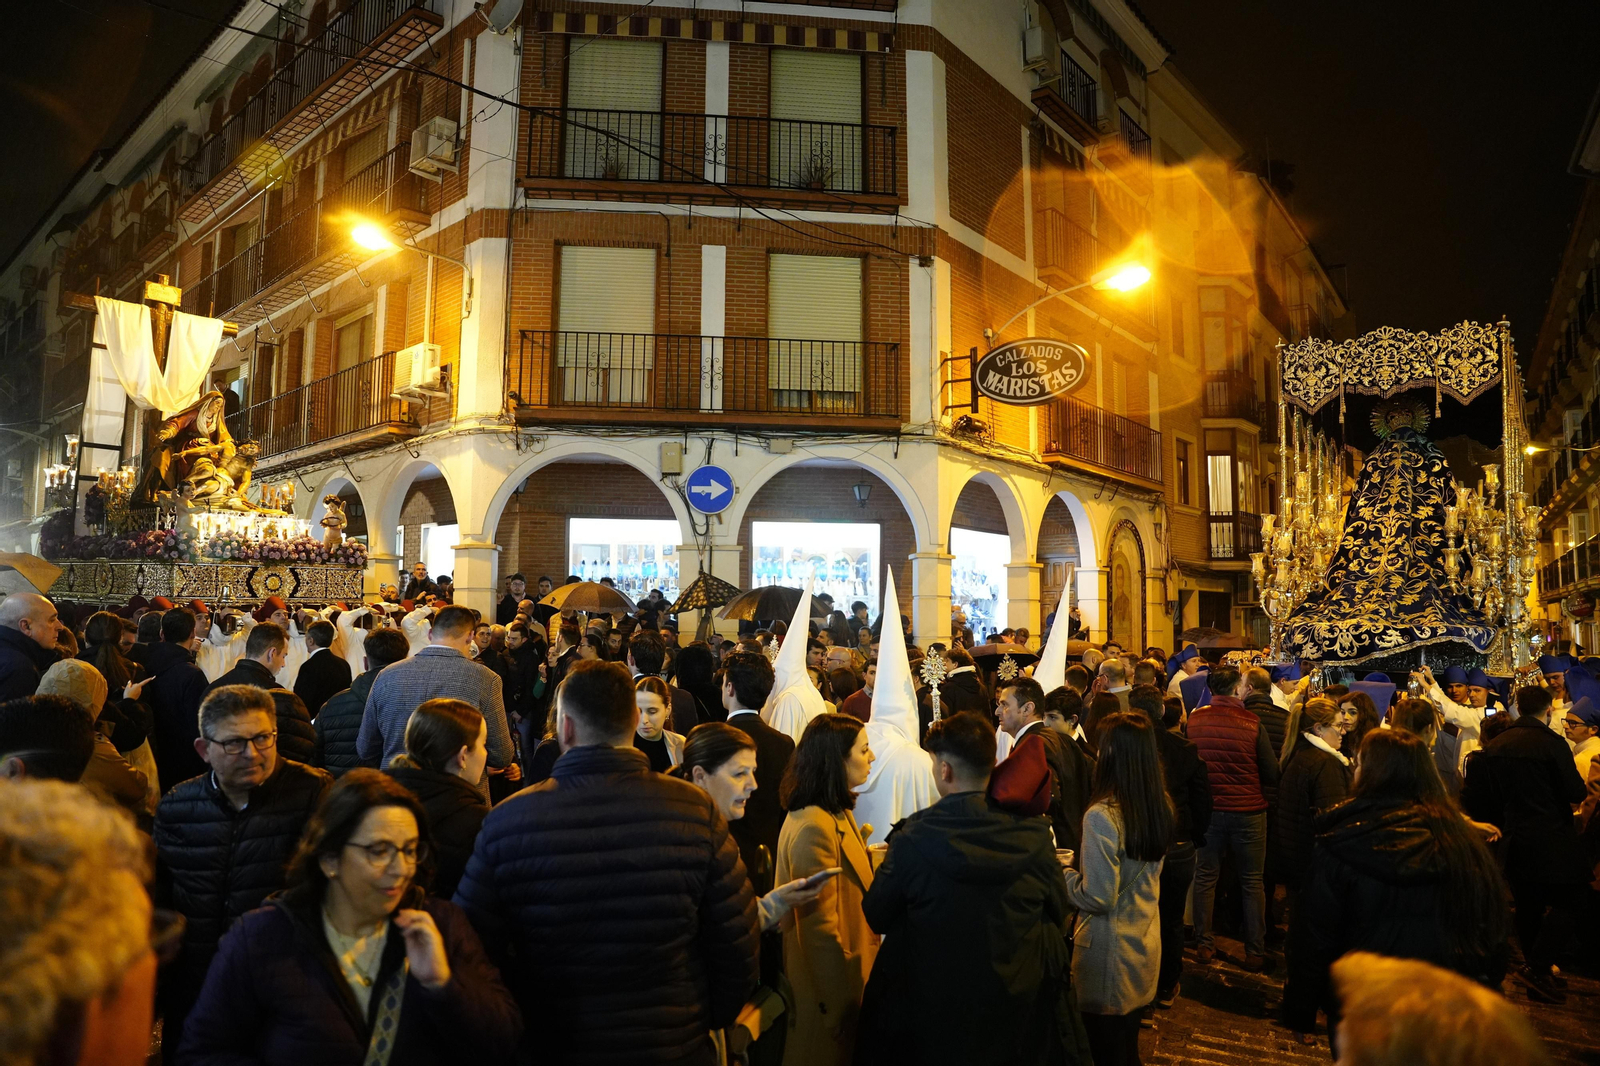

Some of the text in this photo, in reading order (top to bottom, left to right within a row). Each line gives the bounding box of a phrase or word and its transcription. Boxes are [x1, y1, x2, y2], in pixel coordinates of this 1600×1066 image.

[996, 345, 1063, 367] CALZADOS
[982, 361, 1077, 397] MARISTAS
[1011, 360, 1048, 377] LOS
